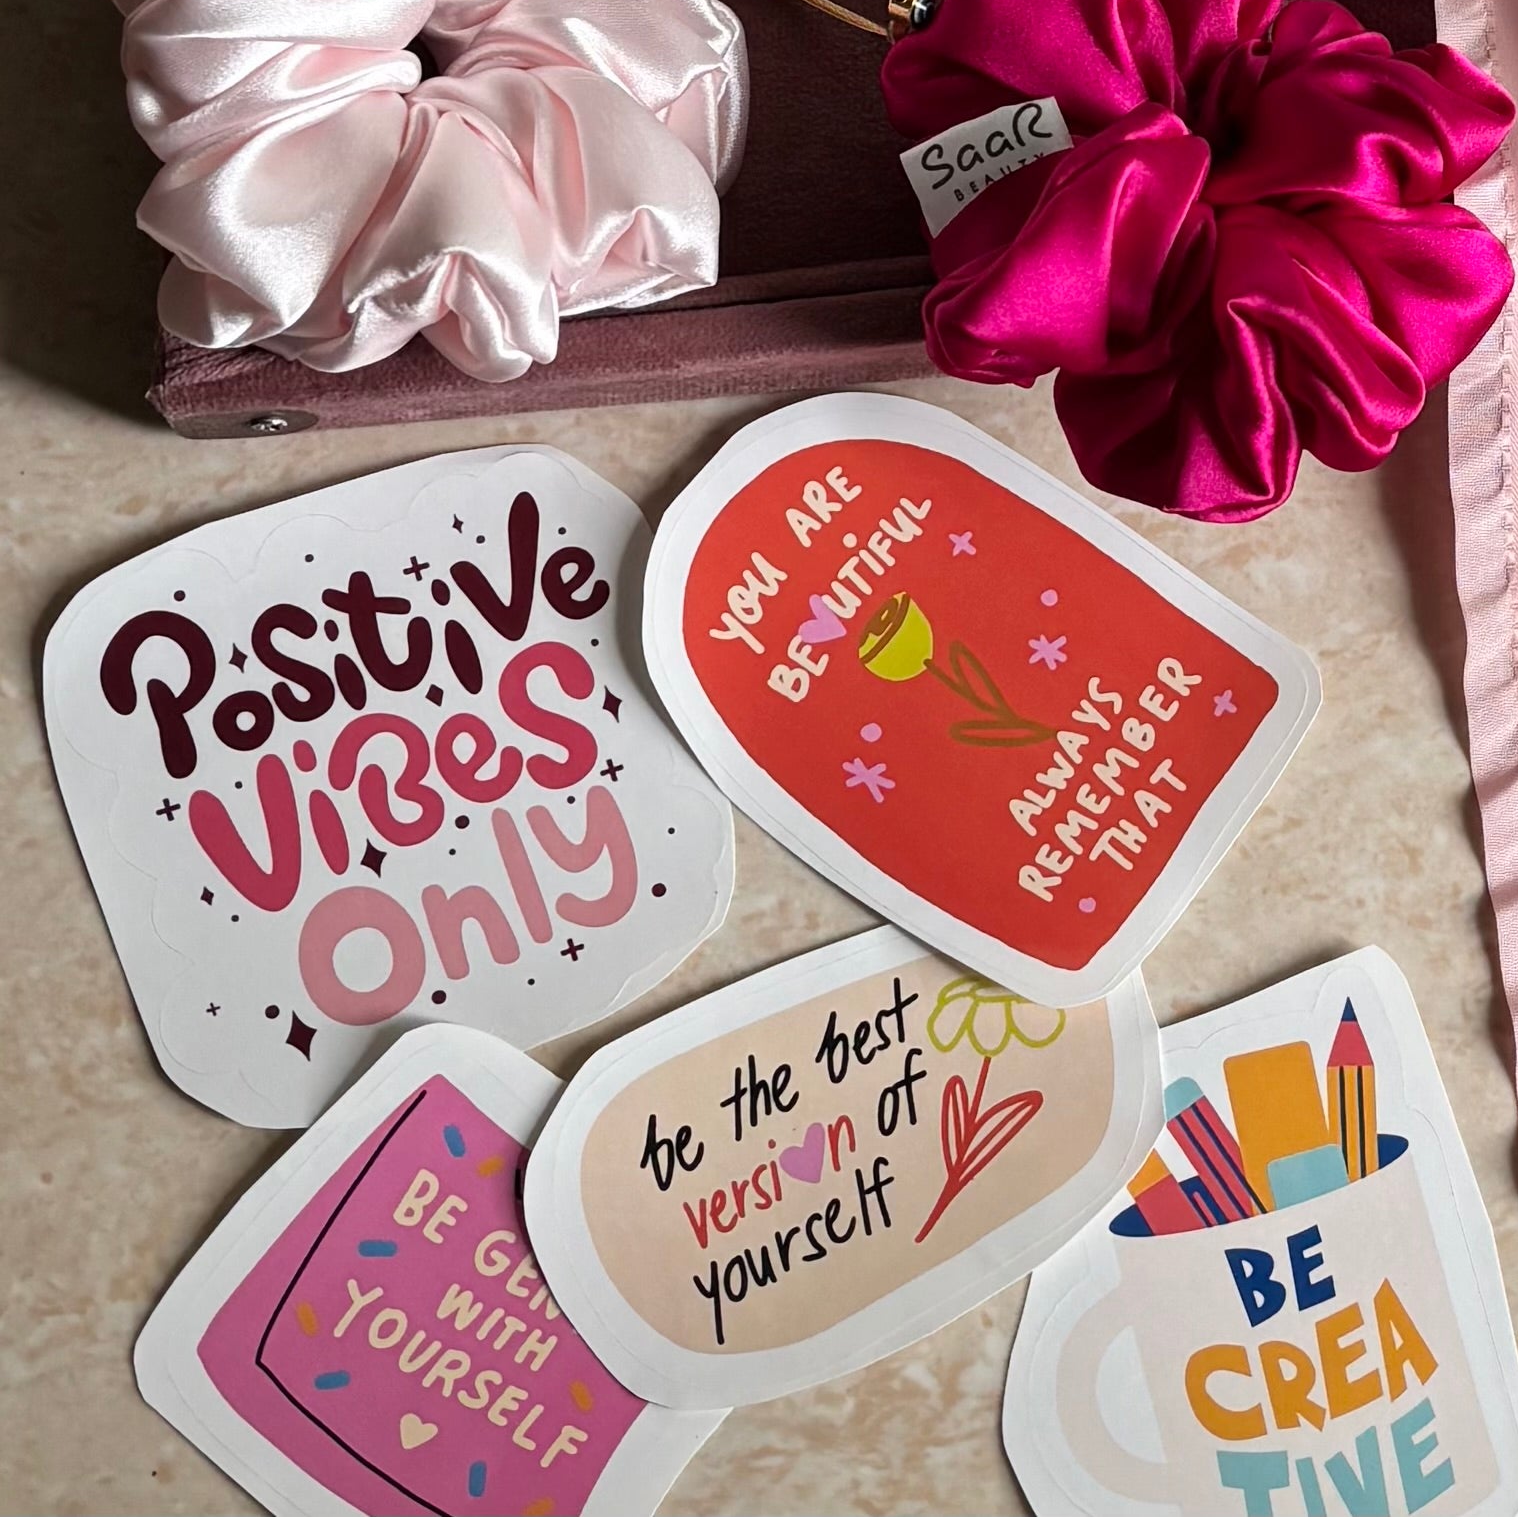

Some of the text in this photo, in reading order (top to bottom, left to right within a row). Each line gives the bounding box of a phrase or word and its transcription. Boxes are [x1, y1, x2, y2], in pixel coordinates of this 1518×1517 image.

[920, 102, 1053, 191] SaaR
[708, 465, 863, 655] YOU ARE
[1008, 676, 1124, 837] ALWAYS
[1018, 657, 1203, 903] REMEMBER
[1088, 758, 1188, 871] THAT
[640, 977, 919, 1192] be the best
[682, 1048, 927, 1250] versin of
[392, 1168, 562, 1321] BE GEN
[693, 1156, 895, 1346] yourself
[1224, 1223, 1337, 1329] BE
[333, 1278, 589, 1468] YOURSELF
[435, 1283, 558, 1372] WITH
[1184, 1277, 1439, 1442] CREA
[1216, 1398, 1456, 1517] TIVE
